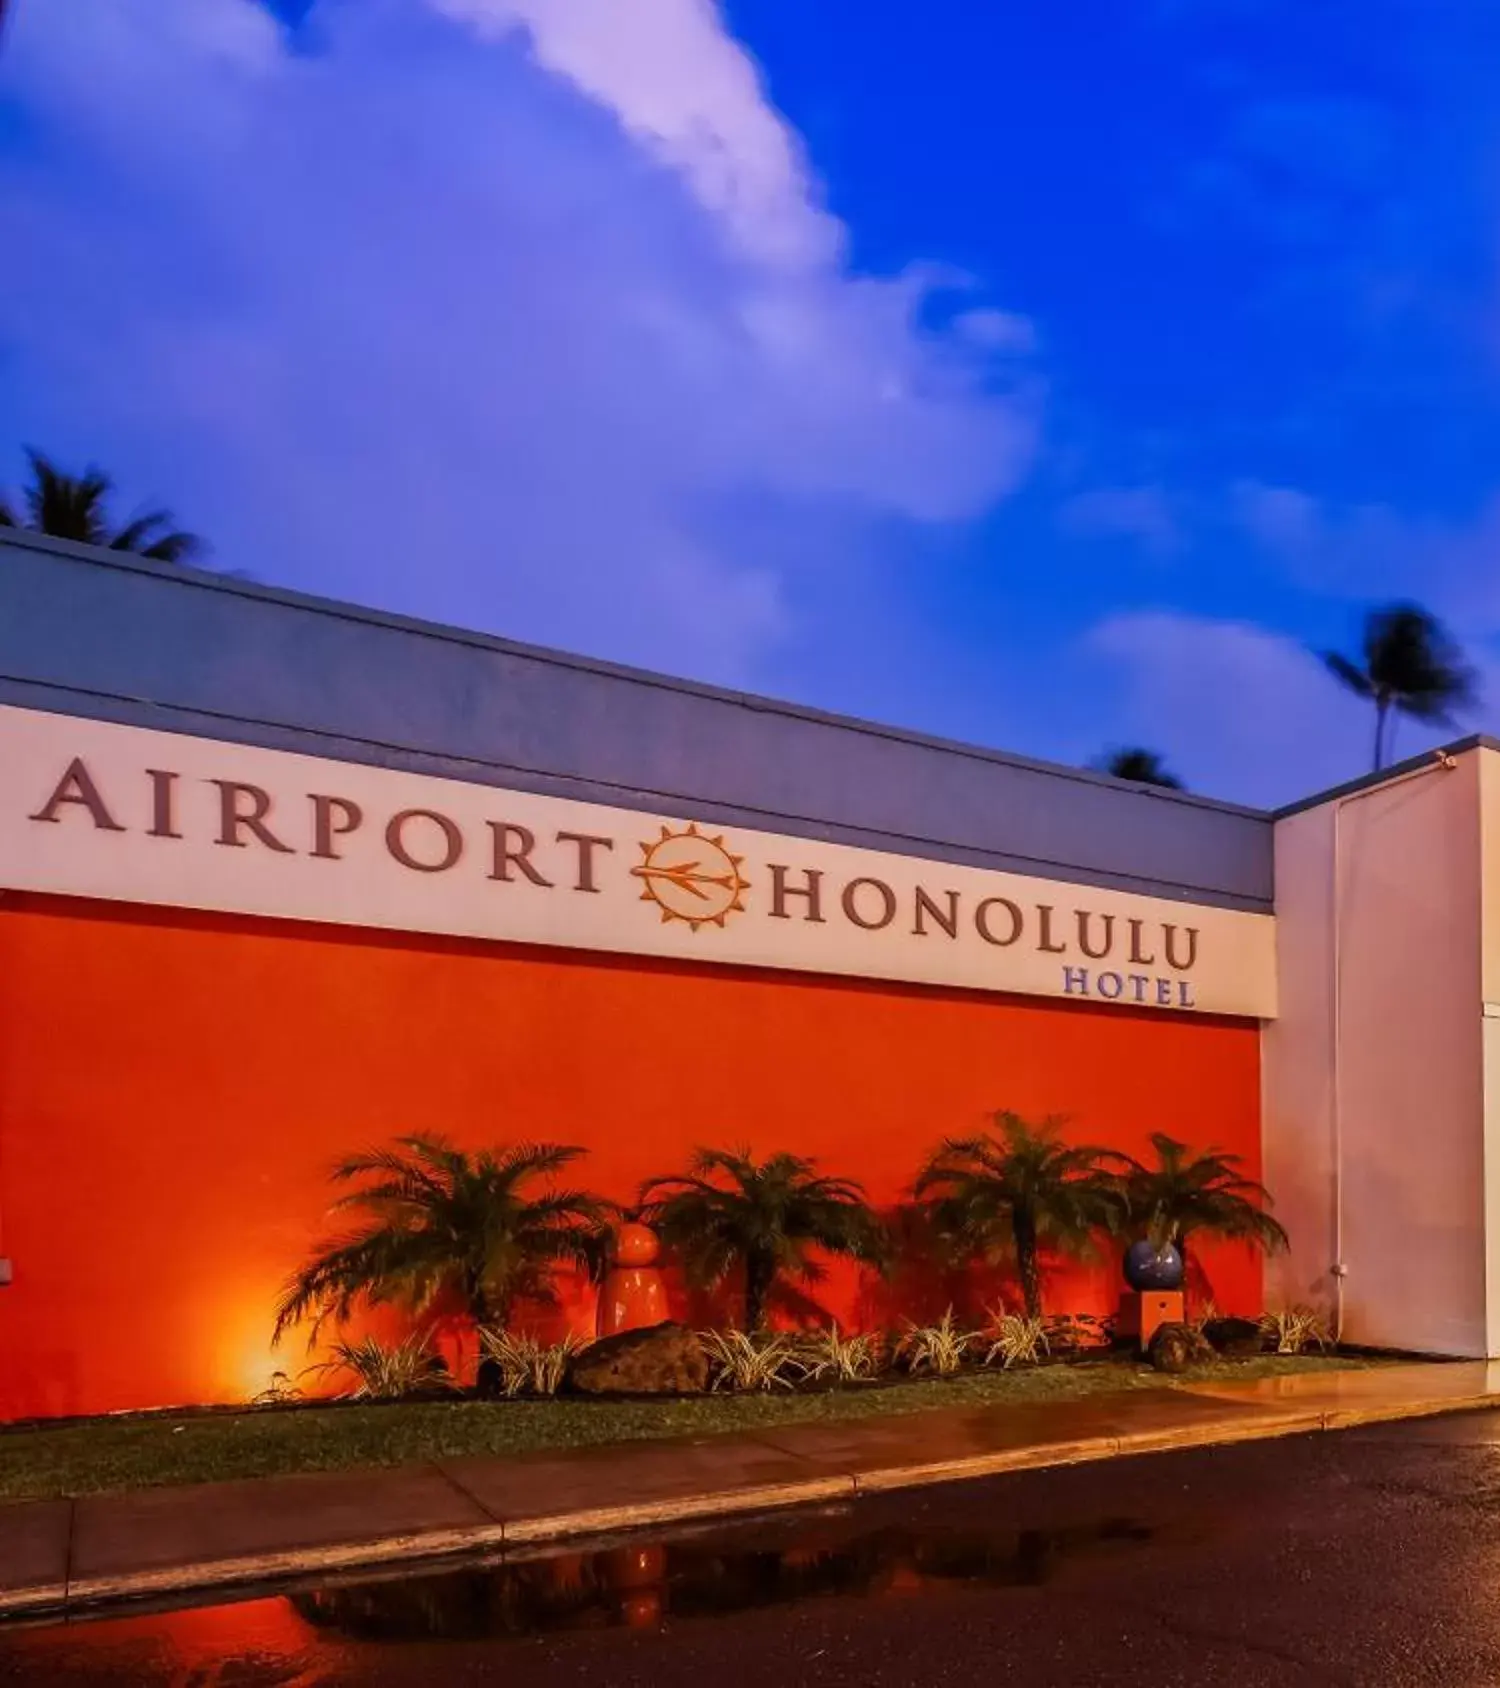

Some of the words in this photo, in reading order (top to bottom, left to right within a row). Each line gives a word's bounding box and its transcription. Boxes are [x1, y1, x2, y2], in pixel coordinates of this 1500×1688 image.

[28, 757, 613, 893] AIRPORT
[765, 864, 1201, 971] HONOLULU
[1062, 966, 1195, 1007] HOTEL
